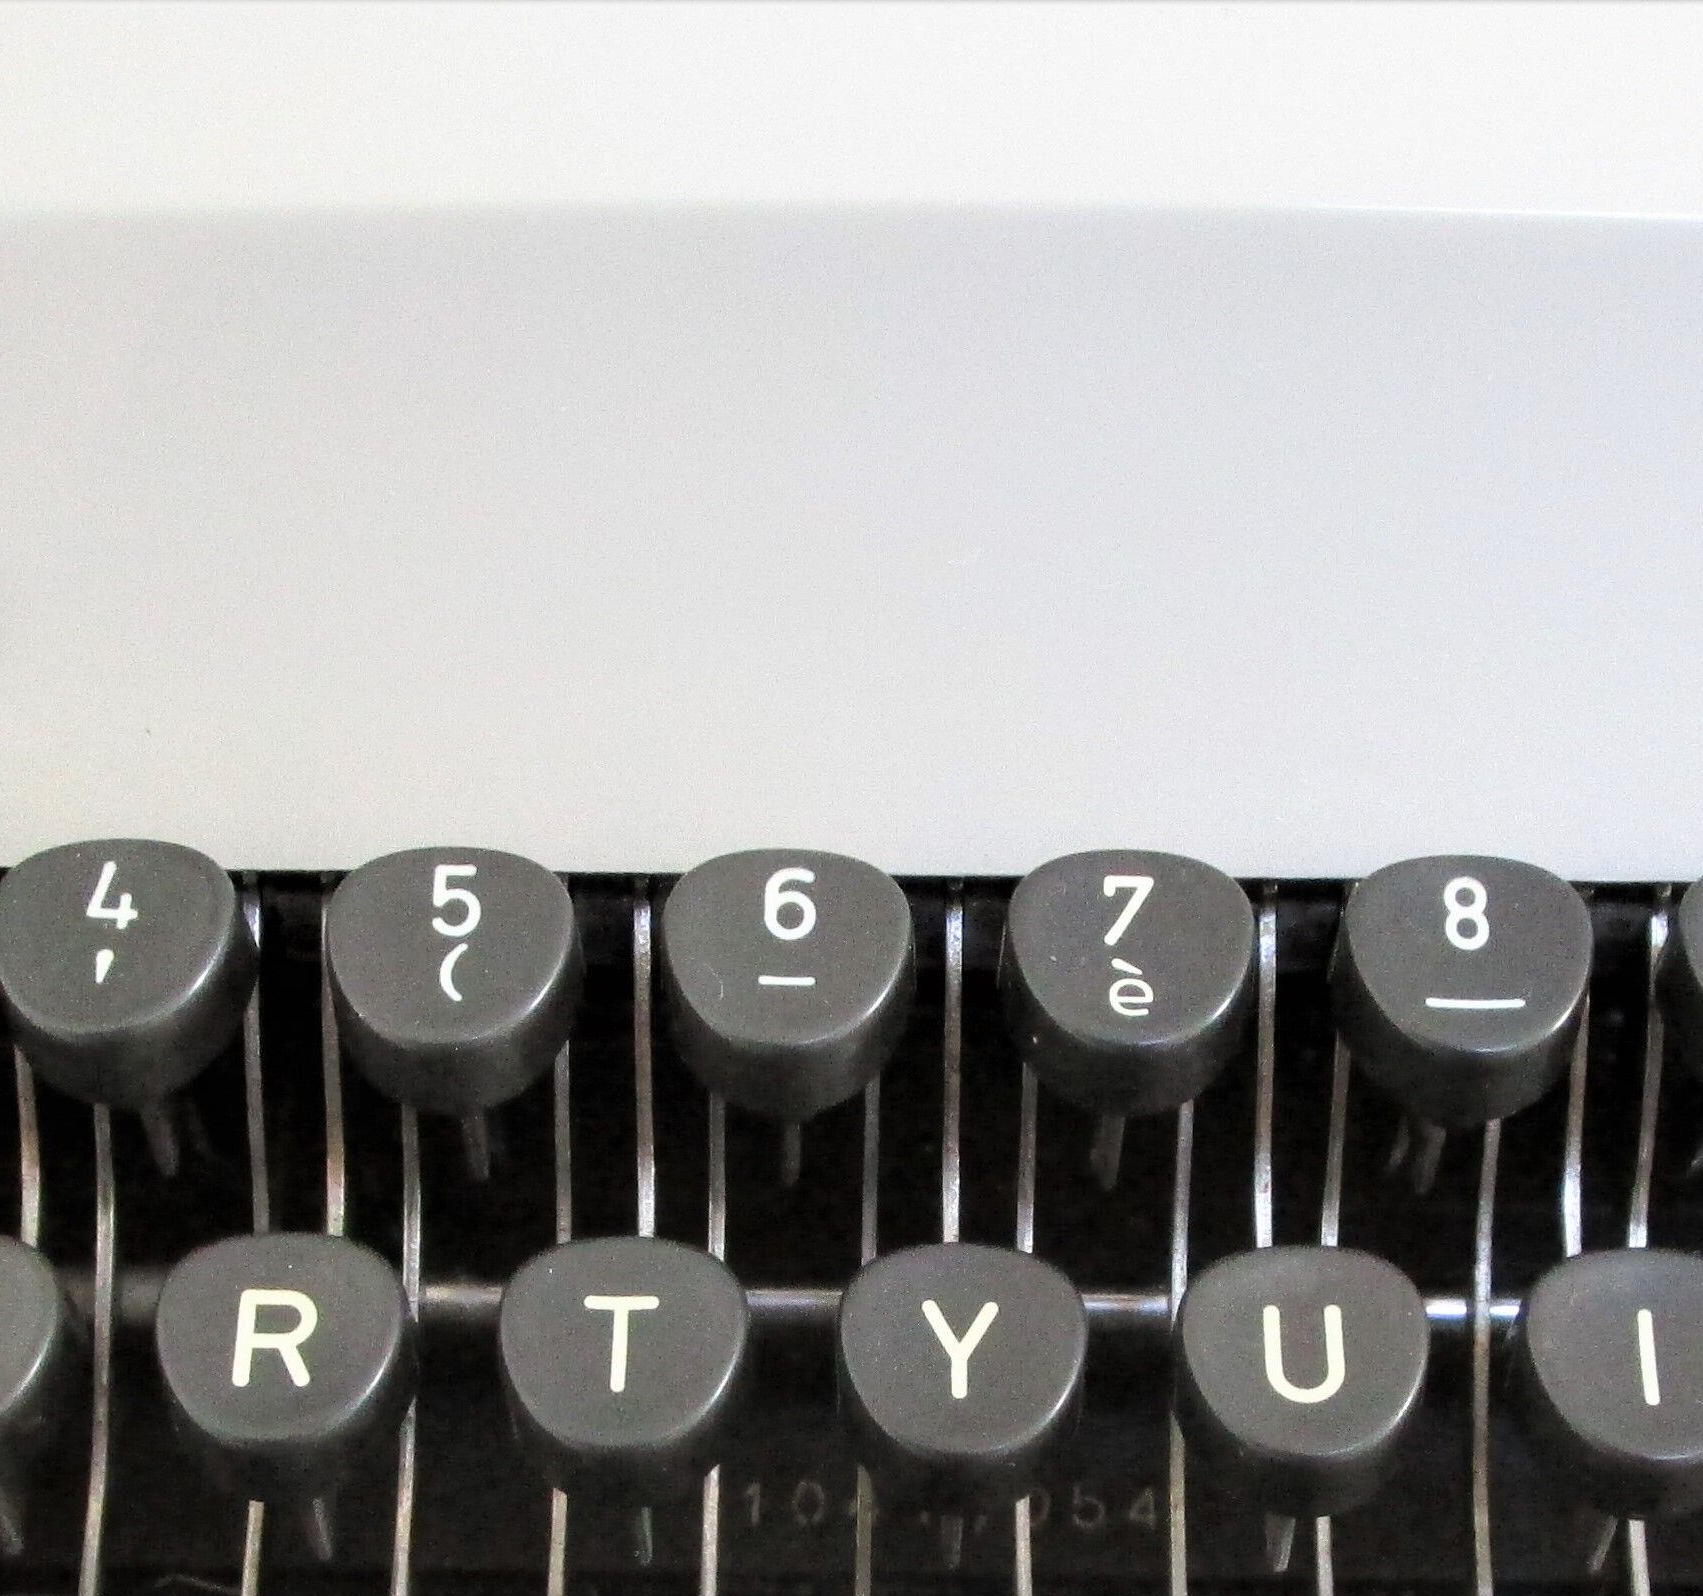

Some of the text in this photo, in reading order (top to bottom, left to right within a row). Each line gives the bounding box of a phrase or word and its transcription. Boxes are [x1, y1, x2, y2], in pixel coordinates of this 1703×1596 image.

[84, 859, 140, 931] 4
[430, 862, 483, 934] 5
[762, 864, 818, 943] 6
[1101, 873, 1156, 948] 7
[1439, 874, 1492, 953] 8
[1107, 956, 1155, 1019] è
[229, 1286, 320, 1389] R
[582, 1293, 662, 1395] T
[920, 1298, 1001, 1401] Y
[1260, 1302, 1347, 1406] U
[1635, 1306, 1662, 1408] I
